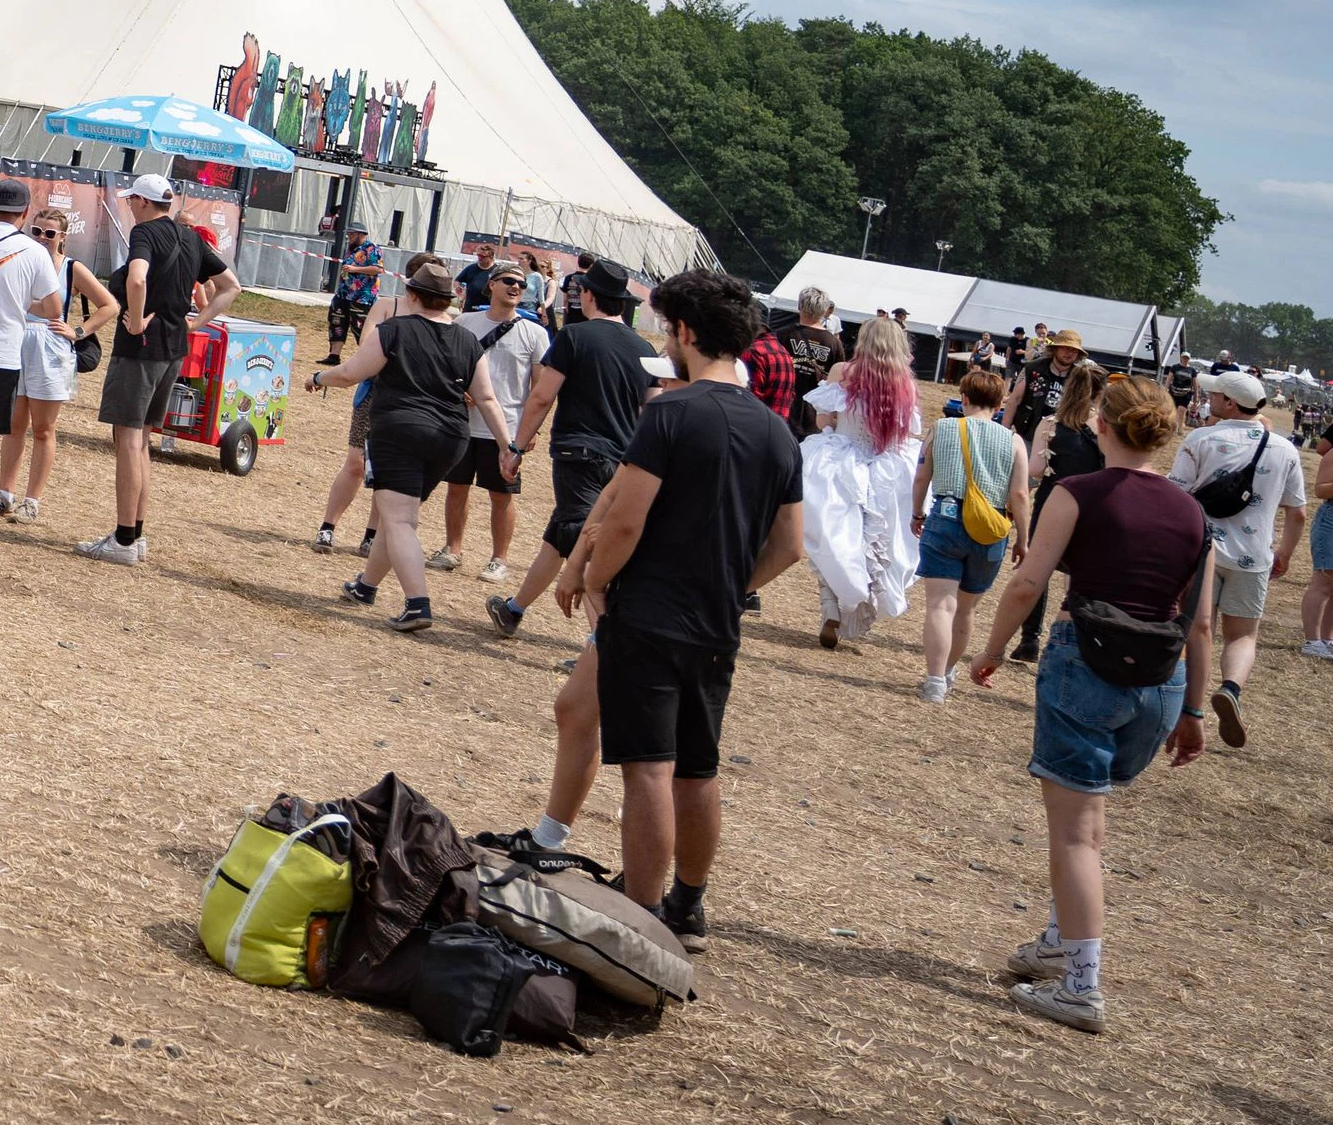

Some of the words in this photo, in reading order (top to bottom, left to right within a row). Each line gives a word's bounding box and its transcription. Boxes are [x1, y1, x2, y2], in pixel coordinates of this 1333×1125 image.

[77, 122, 141, 139] BEN&JERRY'S
[160, 136, 233, 153] BEN&JERRY'S
[789, 338, 831, 362] VANS
